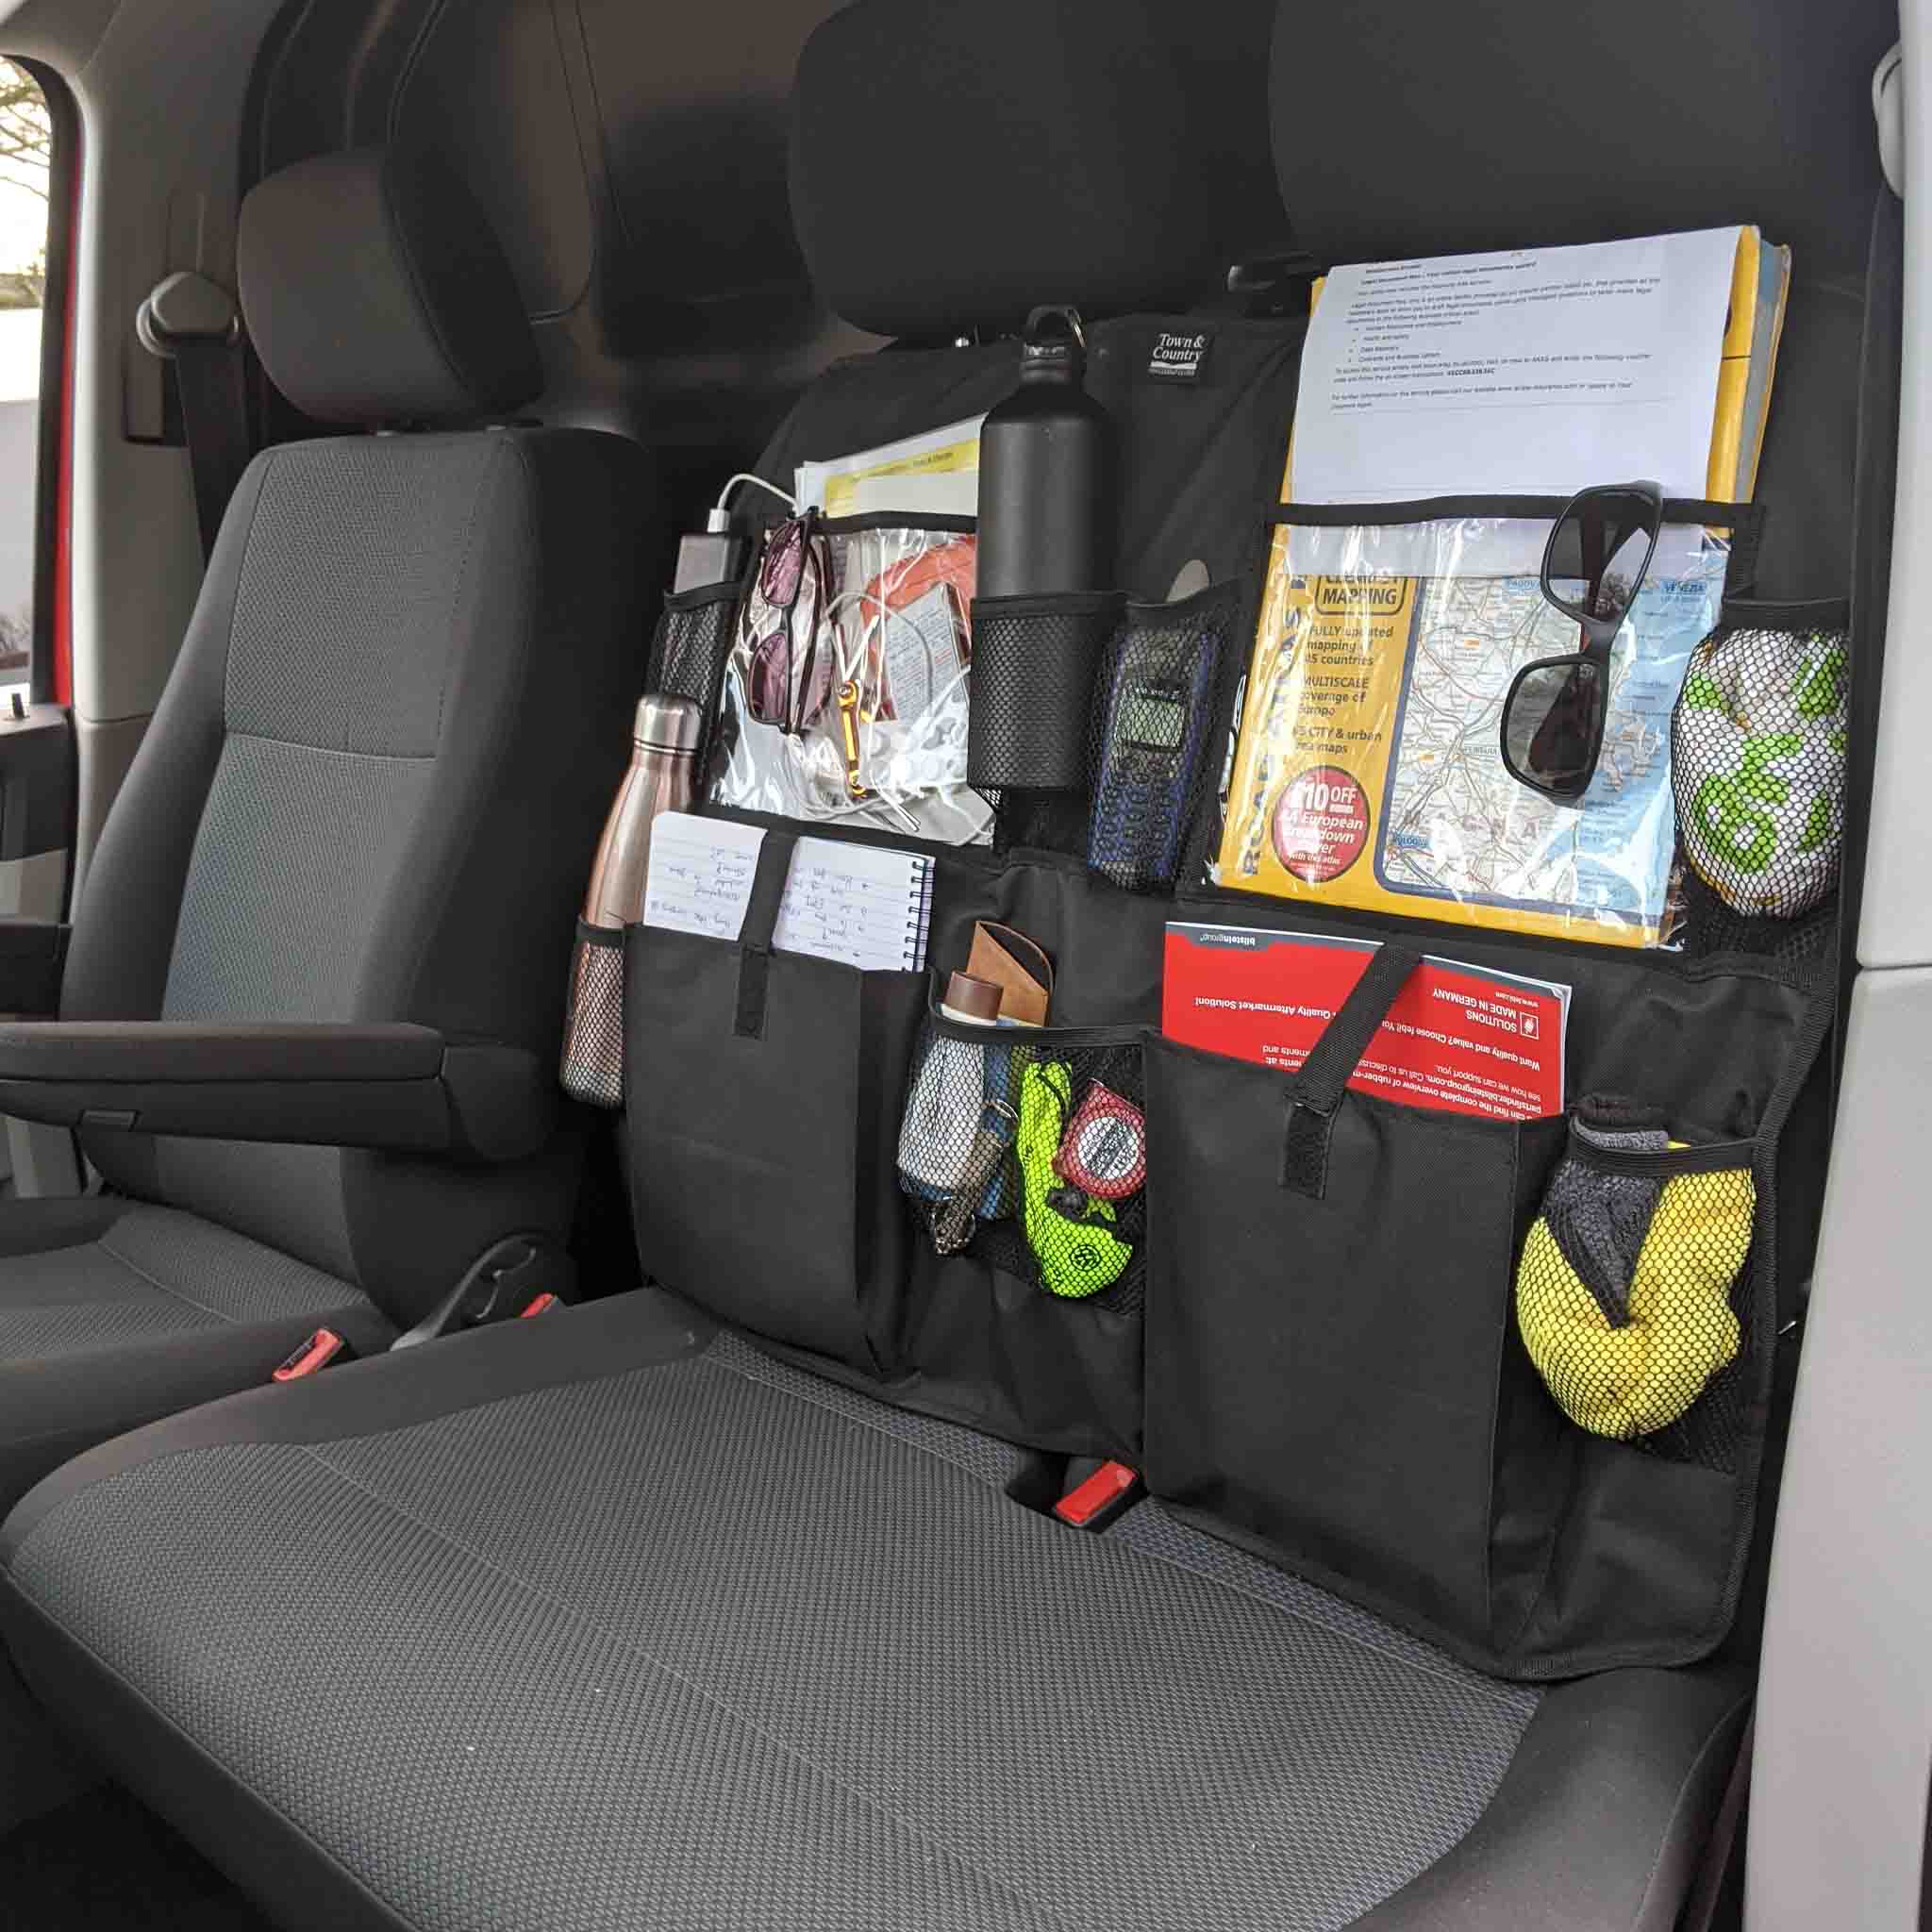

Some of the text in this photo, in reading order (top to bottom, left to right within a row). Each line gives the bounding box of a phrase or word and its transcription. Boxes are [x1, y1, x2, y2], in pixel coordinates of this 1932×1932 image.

[1158, 333, 1207, 348] Town &
[1152, 345, 1204, 363] Country
[1307, 641, 1357, 654] mapping
[1299, 691, 1349, 705] overage
[1335, 727, 1344, 740] &
[1330, 785, 1358, 804] OFF
[1301, 812, 1364, 831] European
[1195, 995, 1332, 1020] Quality Aftermarket Solution!
[1433, 988, 1517, 1020] MADE IN GERMANY
[1465, 1008, 1518, 1033] SOLUTIONS
[1415, 1026, 1447, 1044] Choose
[1262, 1044, 1280, 1055] and
[1448, 1036, 1474, 1050] value?
[1475, 1042, 1491, 1054] and
[1491, 1048, 1519, 1063] quality
[1519, 1055, 1541, 1073] Want
[1392, 1078, 1402, 1088] of
[1402, 1079, 1440, 1097] overview
[1440, 1090, 1478, 1108] complete
[1510, 1086, 1527, 1100] how
[1478, 1100, 1492, 1112] the
